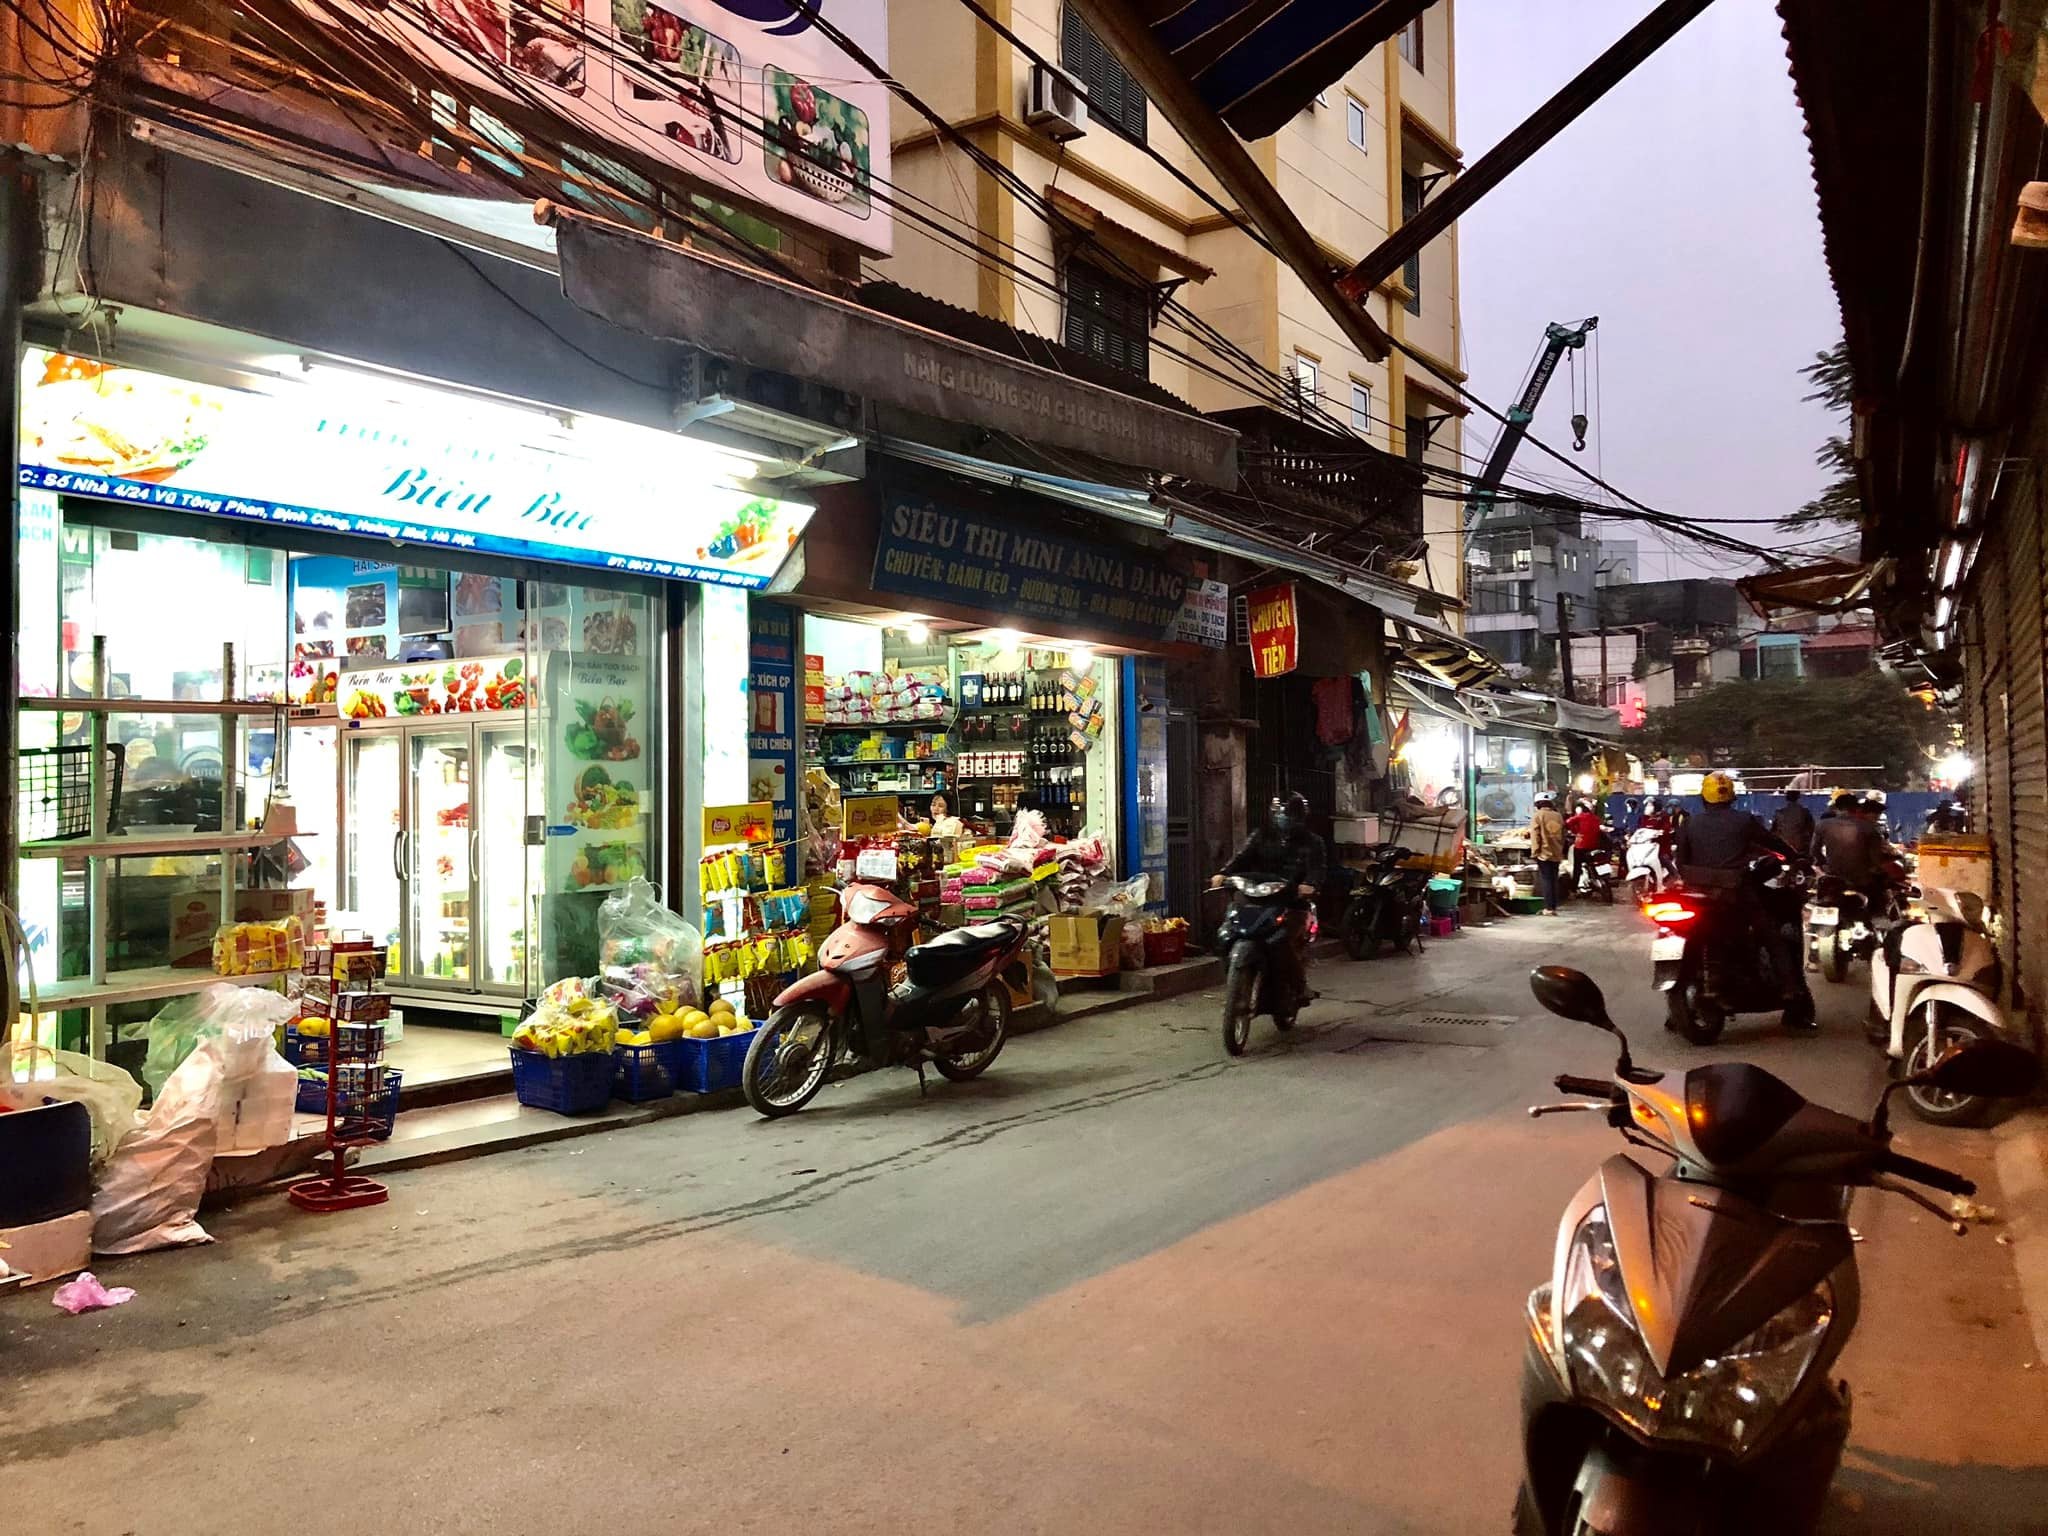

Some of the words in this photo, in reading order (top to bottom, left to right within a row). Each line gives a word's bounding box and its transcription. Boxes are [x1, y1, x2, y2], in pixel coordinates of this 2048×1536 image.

[72, 477, 109, 495] Nhà
[113, 483, 149, 499] 4/24
[891, 503, 960, 549] SIÊU
[962, 521, 1009, 568] THỊ
[1008, 535, 1064, 573] MINI
[1065, 550, 1125, 590] ANNA
[885, 547, 945, 583] CHUYÊN:
[947, 560, 984, 591] BÁNH
[985, 569, 1011, 599] KẸO
[779, 674, 791, 688] CP
